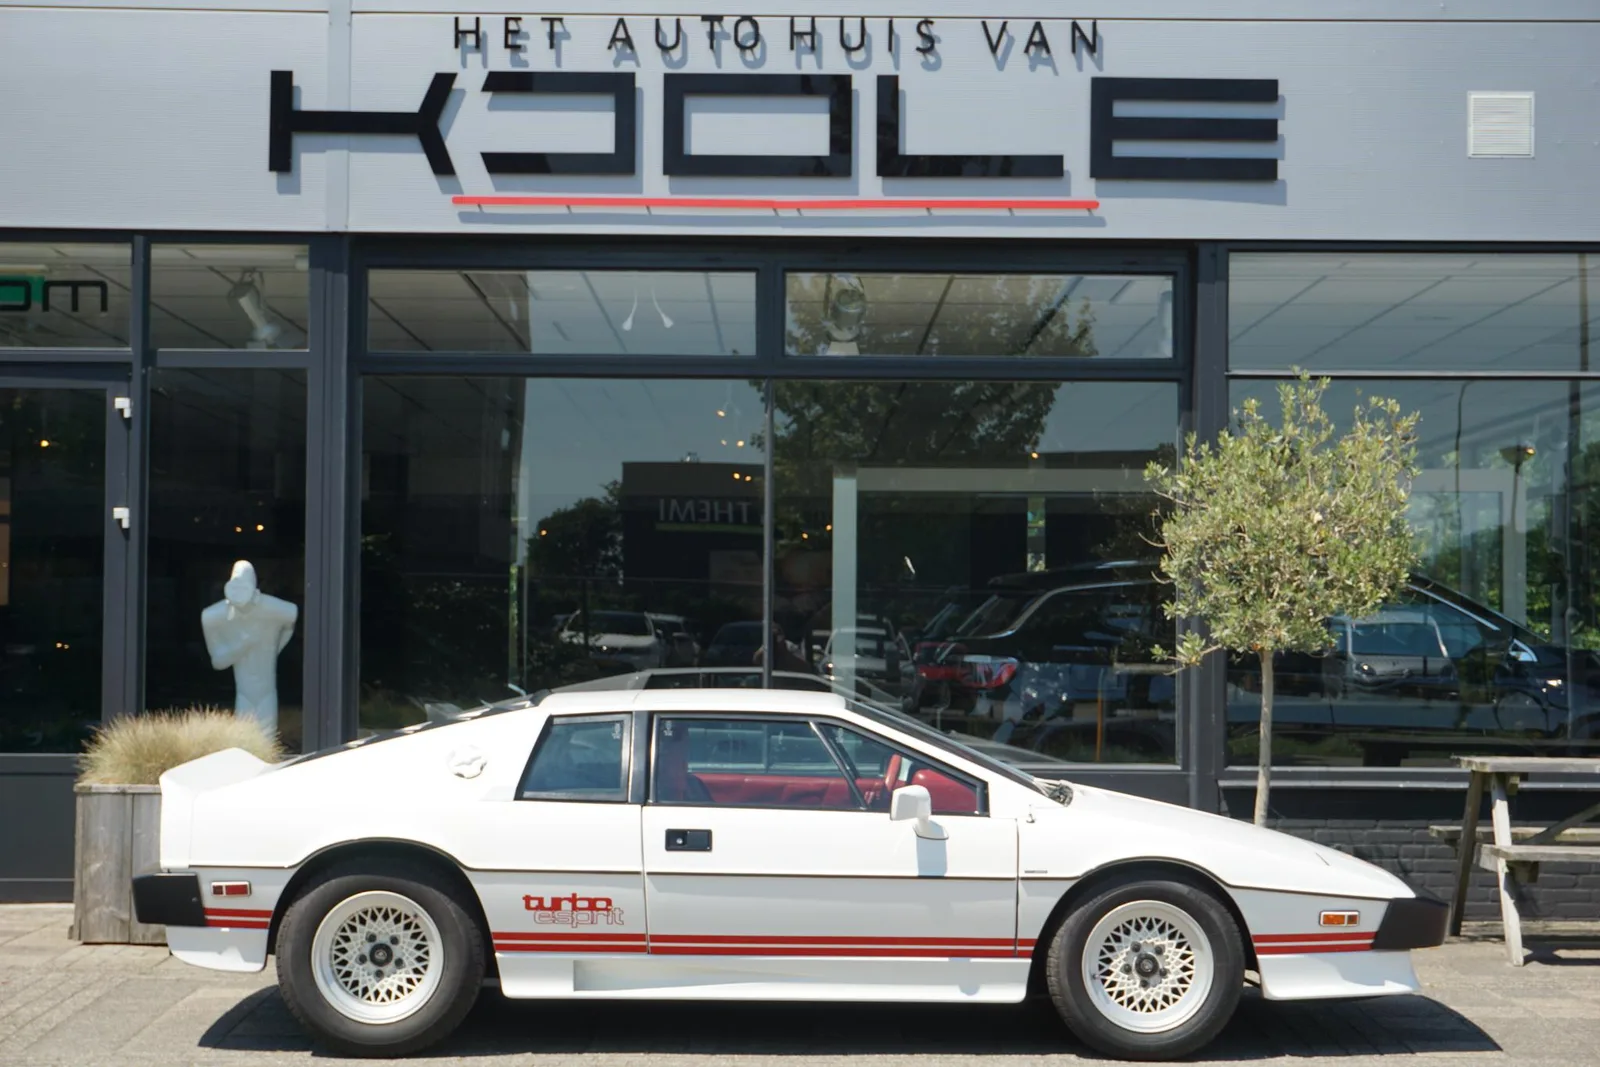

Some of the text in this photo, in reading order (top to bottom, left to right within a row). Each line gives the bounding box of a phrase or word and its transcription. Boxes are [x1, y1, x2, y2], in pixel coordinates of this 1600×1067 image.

[454, 15, 1098, 54] HET AUTOHUIS VAN
[522, 892, 613, 912] turbo
[533, 907, 625, 929] esprit
